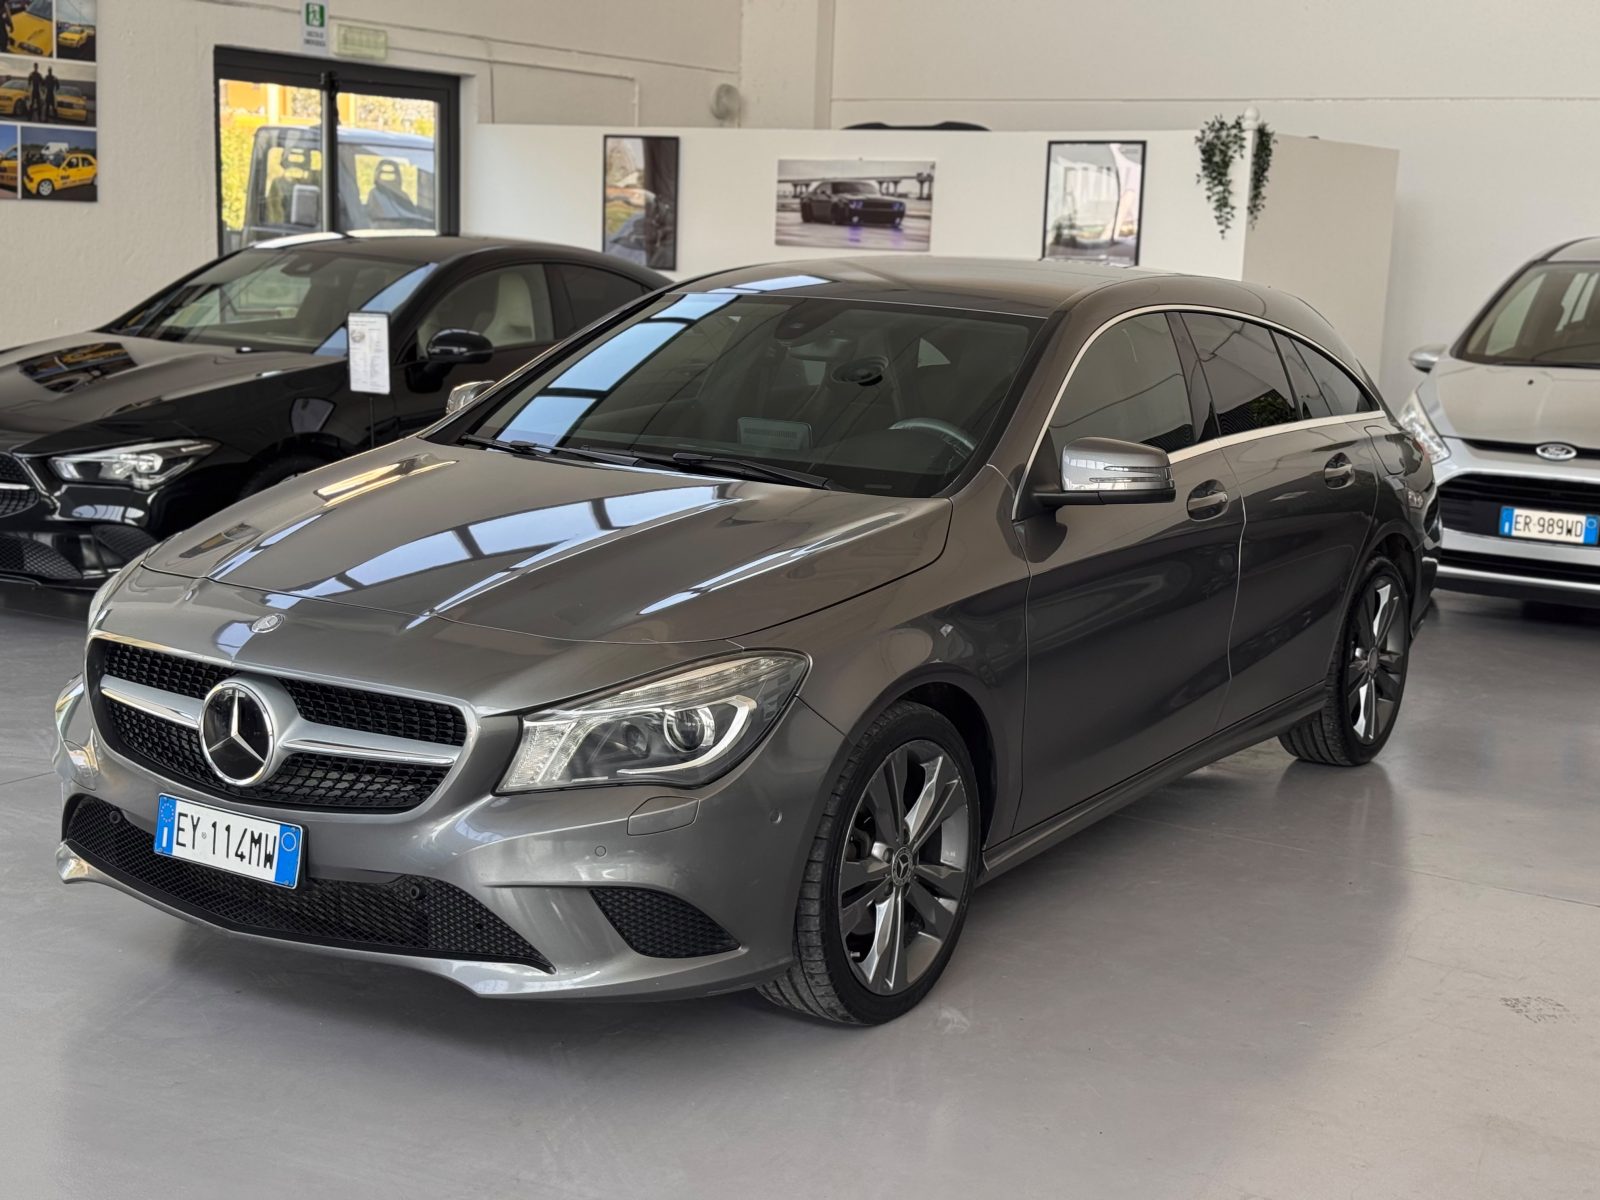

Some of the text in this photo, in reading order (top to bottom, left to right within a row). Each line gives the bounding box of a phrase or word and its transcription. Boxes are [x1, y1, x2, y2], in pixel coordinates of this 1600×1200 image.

[1514, 514, 1584, 537] ER 989WD
[175, 812, 277, 870] EY 114MW
